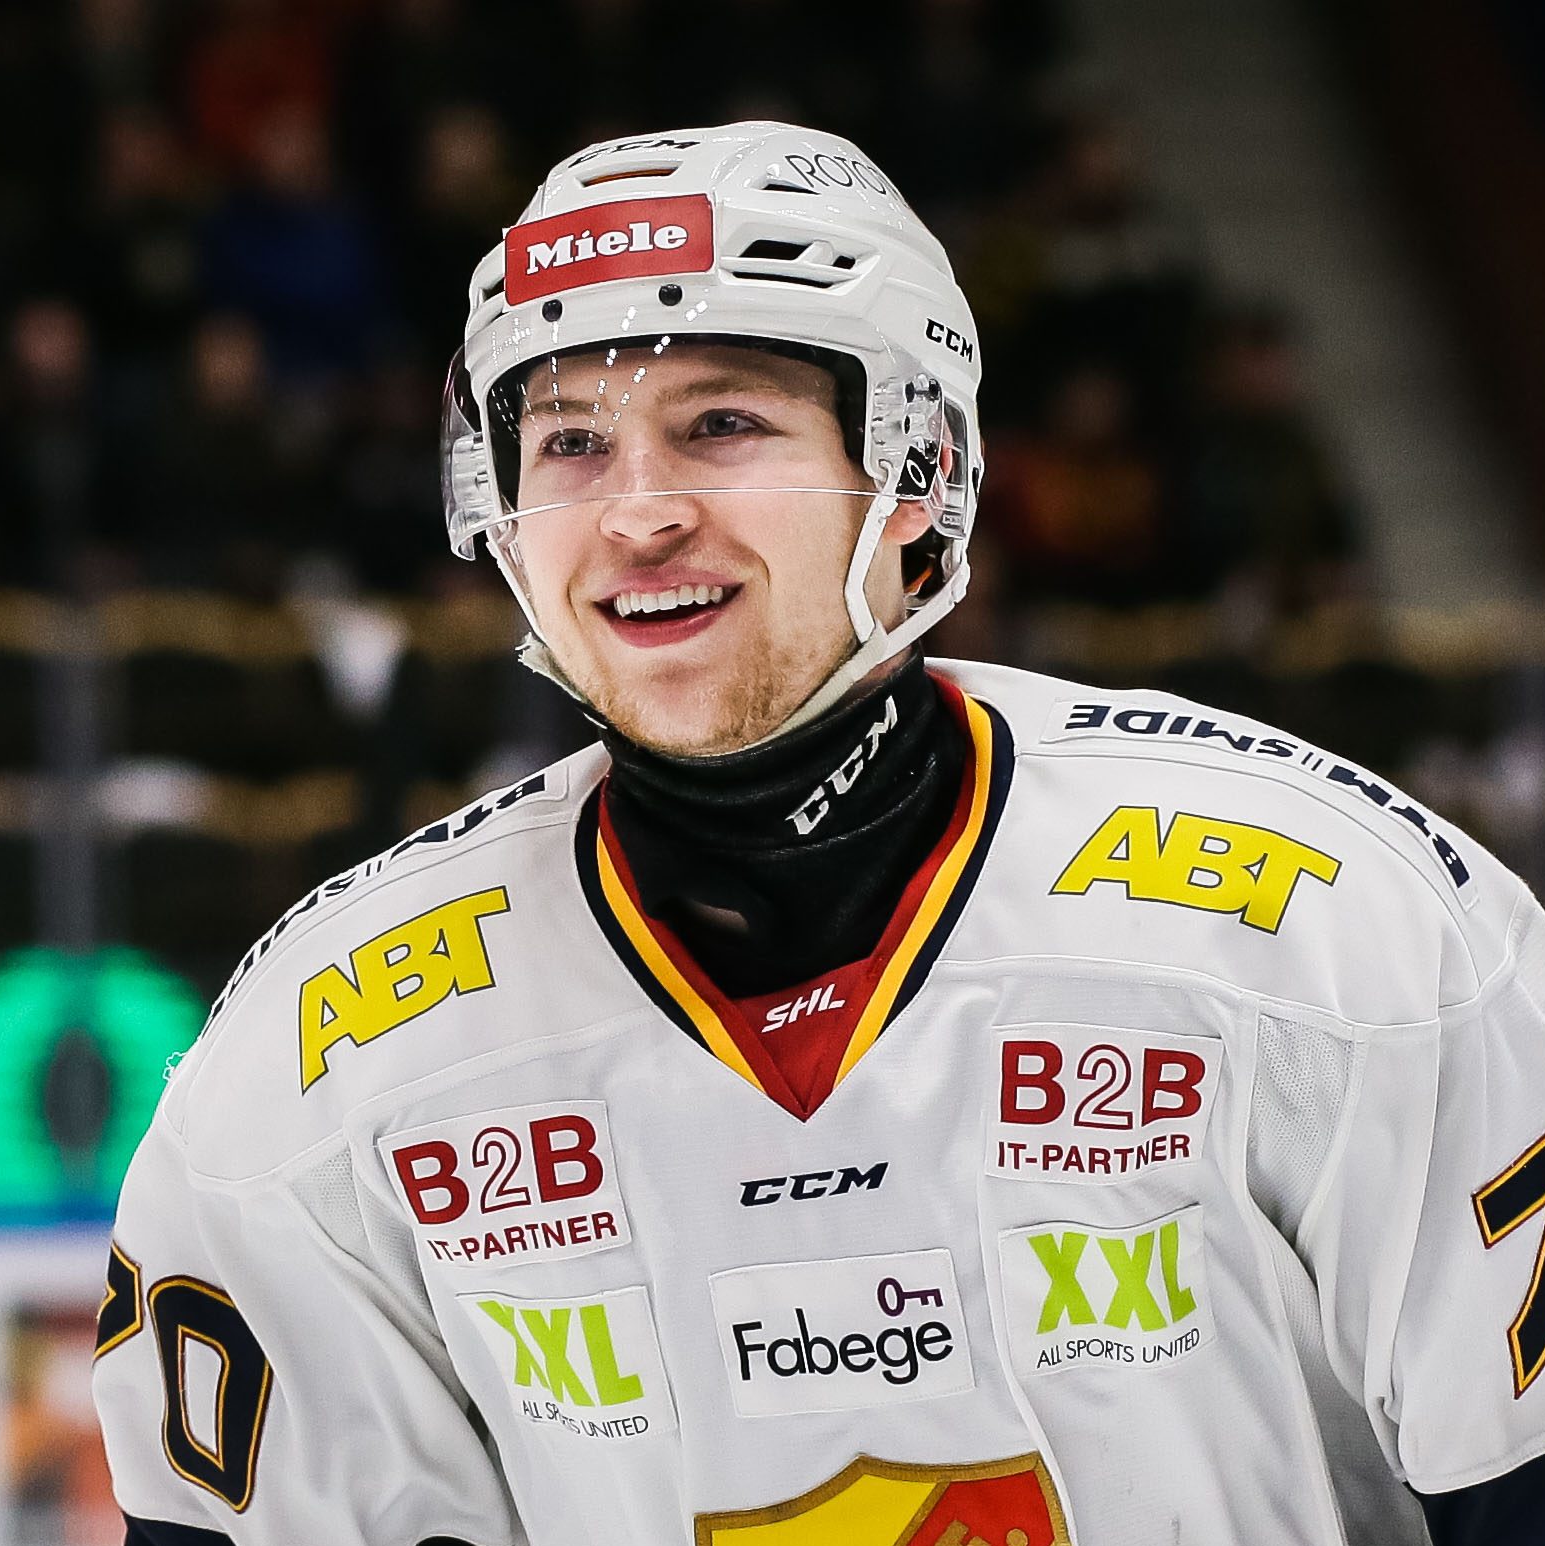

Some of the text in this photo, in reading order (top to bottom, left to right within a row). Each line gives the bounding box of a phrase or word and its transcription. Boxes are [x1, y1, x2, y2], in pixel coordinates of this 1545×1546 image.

[526, 221, 689, 274] Miele
[925, 318, 974, 363] CCM
[785, 695, 898, 835] CCM
[1051, 805, 1342, 934] ABT
[299, 885, 511, 1096] ABT
[761, 983, 846, 1034] SHL
[1000, 1040, 1207, 1131] B2B
[392, 1114, 605, 1226] B2B
[739, 1162, 889, 1207] CCM
[997, 1133, 1191, 1175] IT-PARTNER
[428, 1211, 619, 1262] IT-PARTNER
[1027, 1221, 1198, 1336] XXL
[477, 1301, 645, 1407] XXL
[732, 1307, 953, 1385] Fabege
[1037, 1328, 1200, 1369] ALL SPORTS UNITED
[522, 1400, 542, 1419] ALL
[581, 1415, 649, 1438] UNITED
